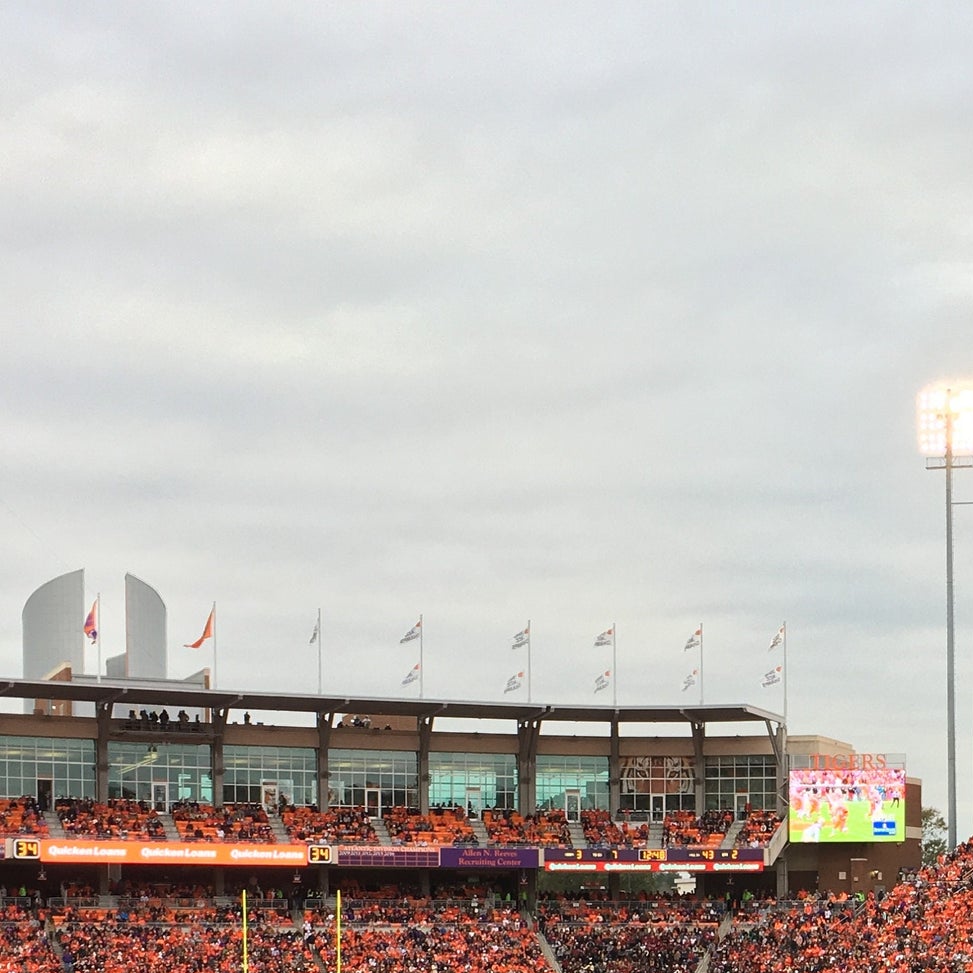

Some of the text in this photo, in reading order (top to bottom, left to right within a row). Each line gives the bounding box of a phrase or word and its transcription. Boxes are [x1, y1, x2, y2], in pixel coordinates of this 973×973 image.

[811, 753, 887, 770] TIGERS
[18, 842, 37, 856] 34
[48, 845, 127, 857] Quicken Loans
[141, 848, 216, 858] Quicken Loans
[462, 849, 518, 857] Allen N. Reeves
[231, 849, 304, 859] Quicken Loans
[312, 848, 328, 860] 34
[576, 850, 582, 859] 3
[612, 850, 618, 859] 7
[702, 850, 714, 859] 43
[731, 850, 738, 859] 2
[458, 858, 521, 867] Recruiting Center
